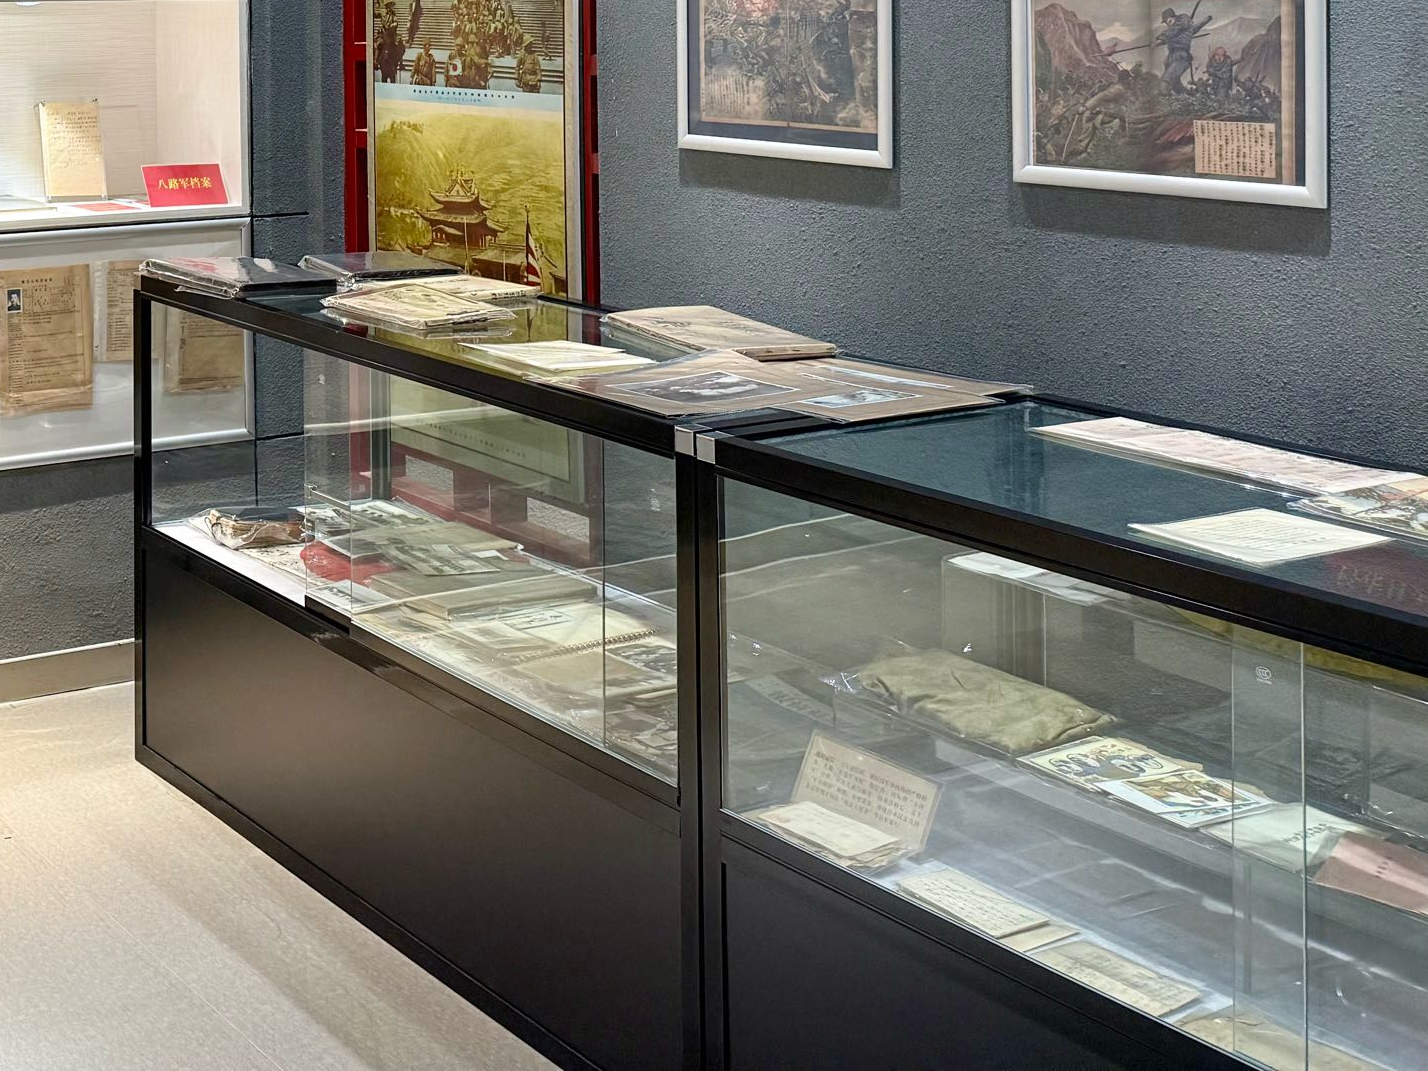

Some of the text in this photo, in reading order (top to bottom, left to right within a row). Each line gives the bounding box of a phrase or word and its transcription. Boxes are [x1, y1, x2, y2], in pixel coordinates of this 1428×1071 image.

[157, 176, 212, 191] 八路军档案
